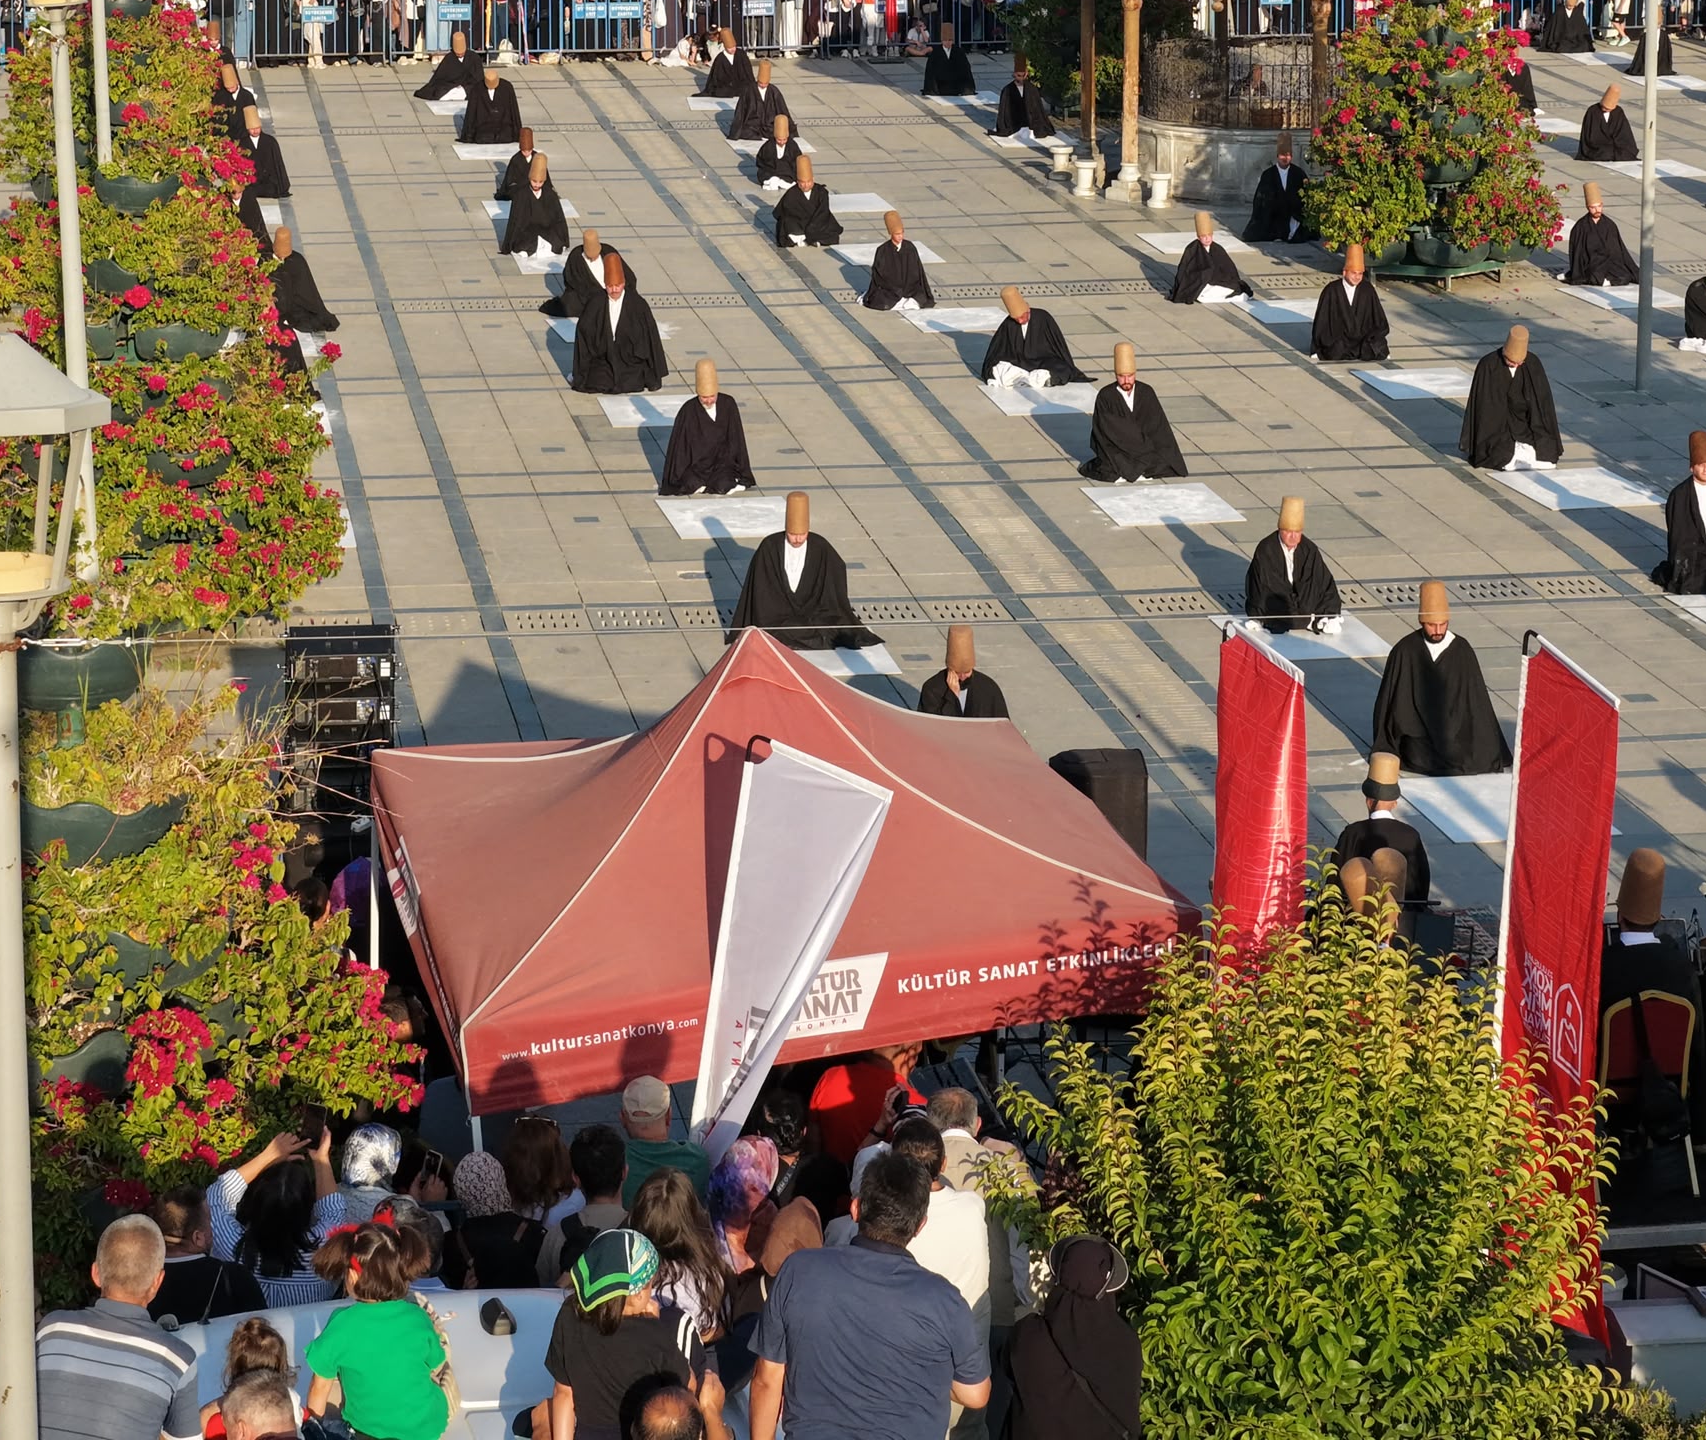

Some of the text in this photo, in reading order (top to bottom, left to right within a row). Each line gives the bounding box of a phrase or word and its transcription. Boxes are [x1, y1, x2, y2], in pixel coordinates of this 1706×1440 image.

[898, 938, 1174, 994] KÜLTÜR SANAT ETKİNLİKLERİ
[501, 1016, 699, 1061] www.kultursanatkonya.com
[795, 1017, 847, 1032] KONYA
